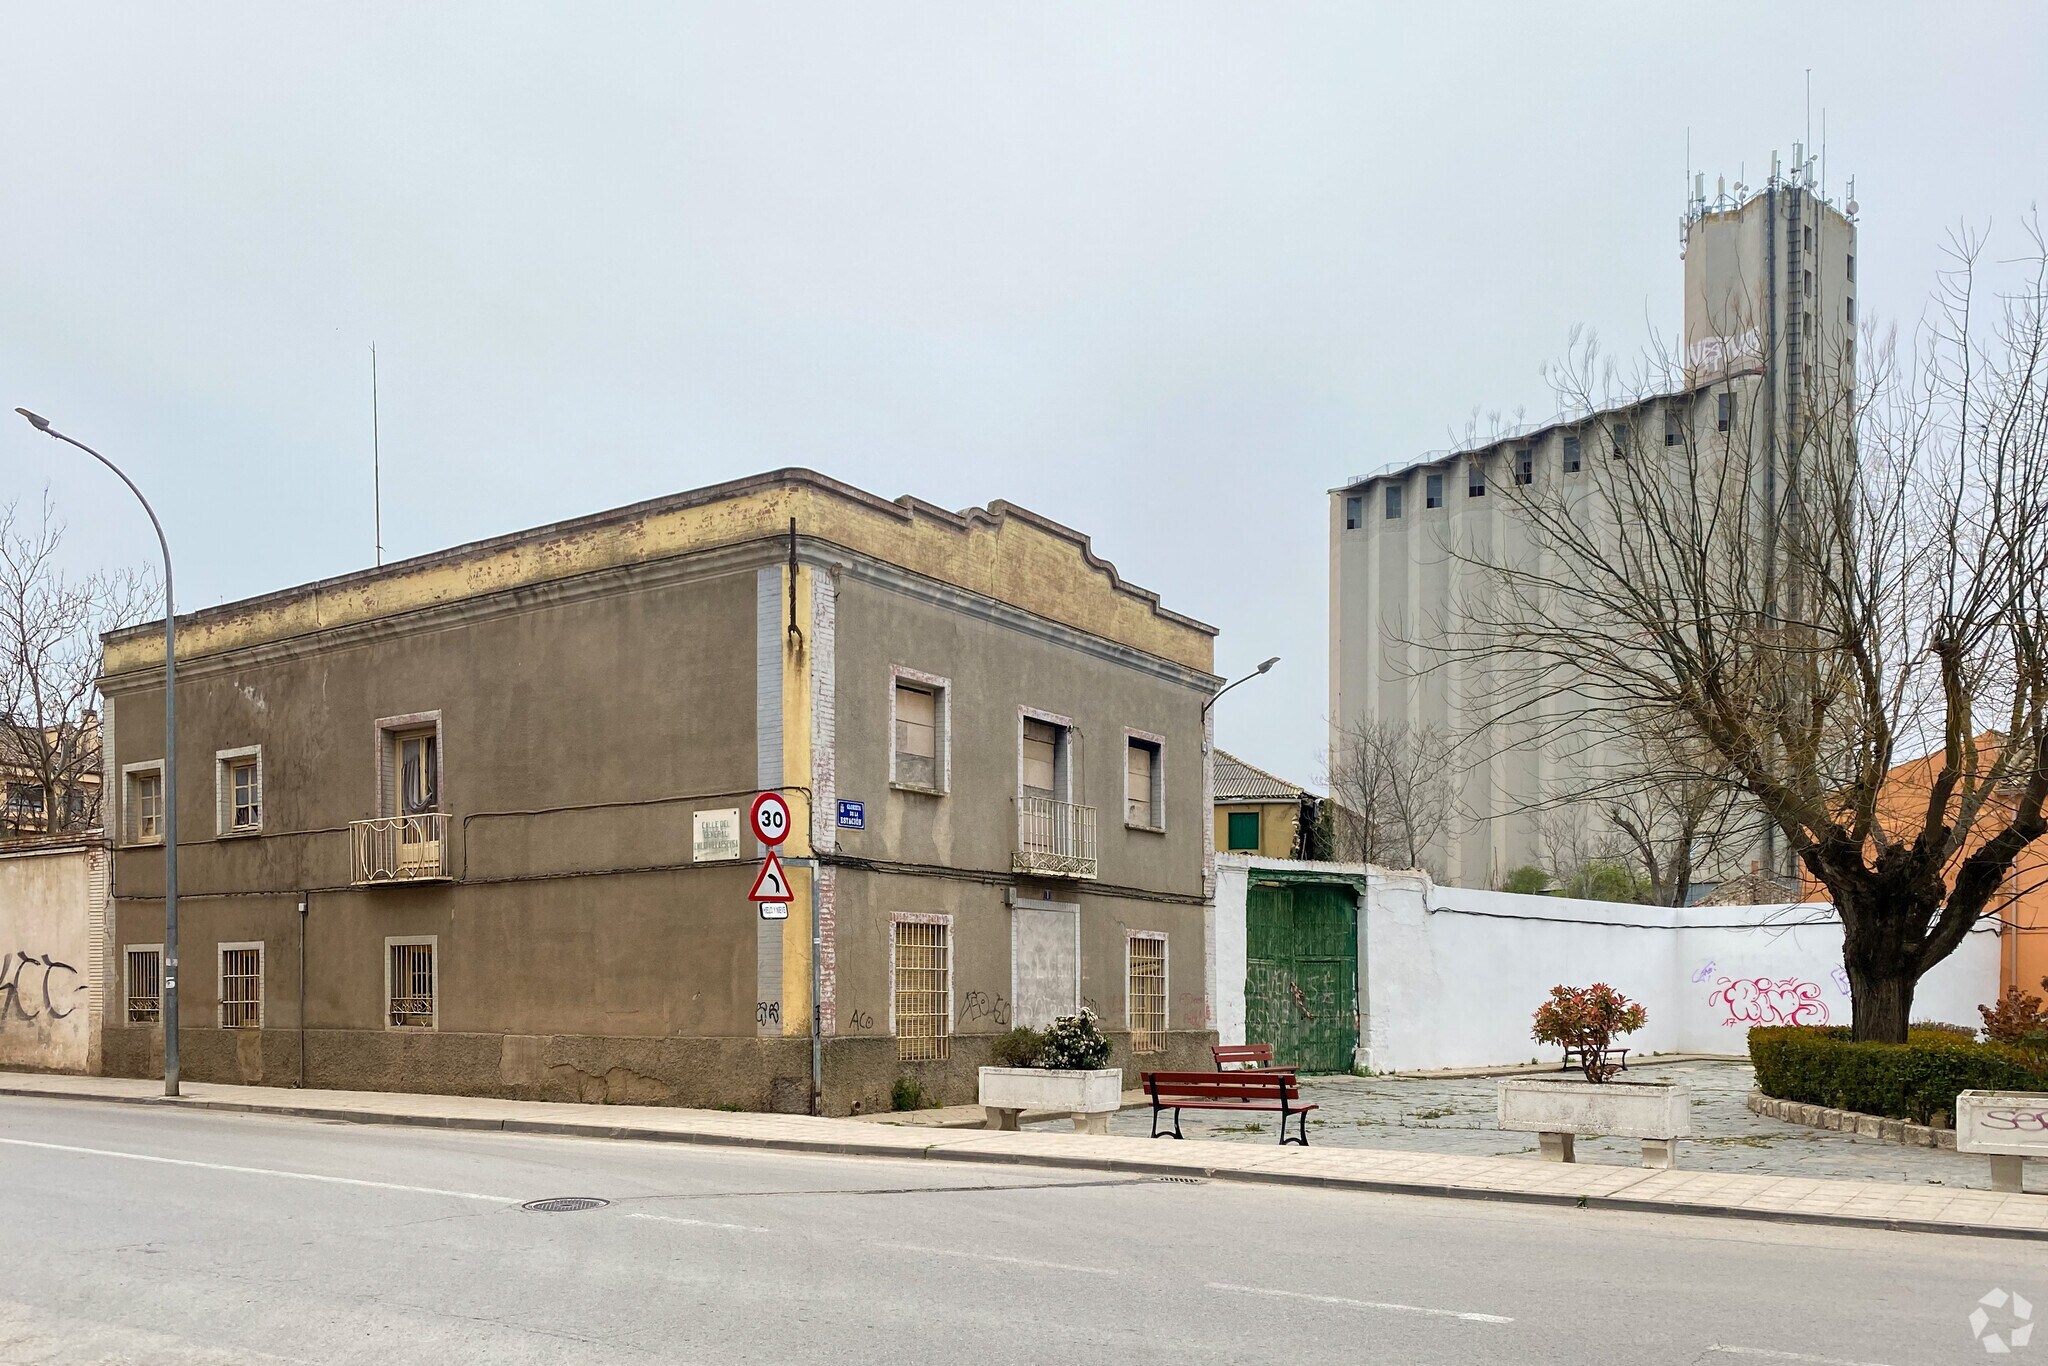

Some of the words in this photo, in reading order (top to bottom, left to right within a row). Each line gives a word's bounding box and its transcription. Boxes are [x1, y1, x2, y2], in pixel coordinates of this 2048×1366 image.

[761, 810, 783, 828] 30
[840, 816, 862, 826] ESTACIÓN
[702, 821, 719, 829] CALLE
[719, 820, 730, 828] DEL
[703, 830, 729, 839] GENERAL
